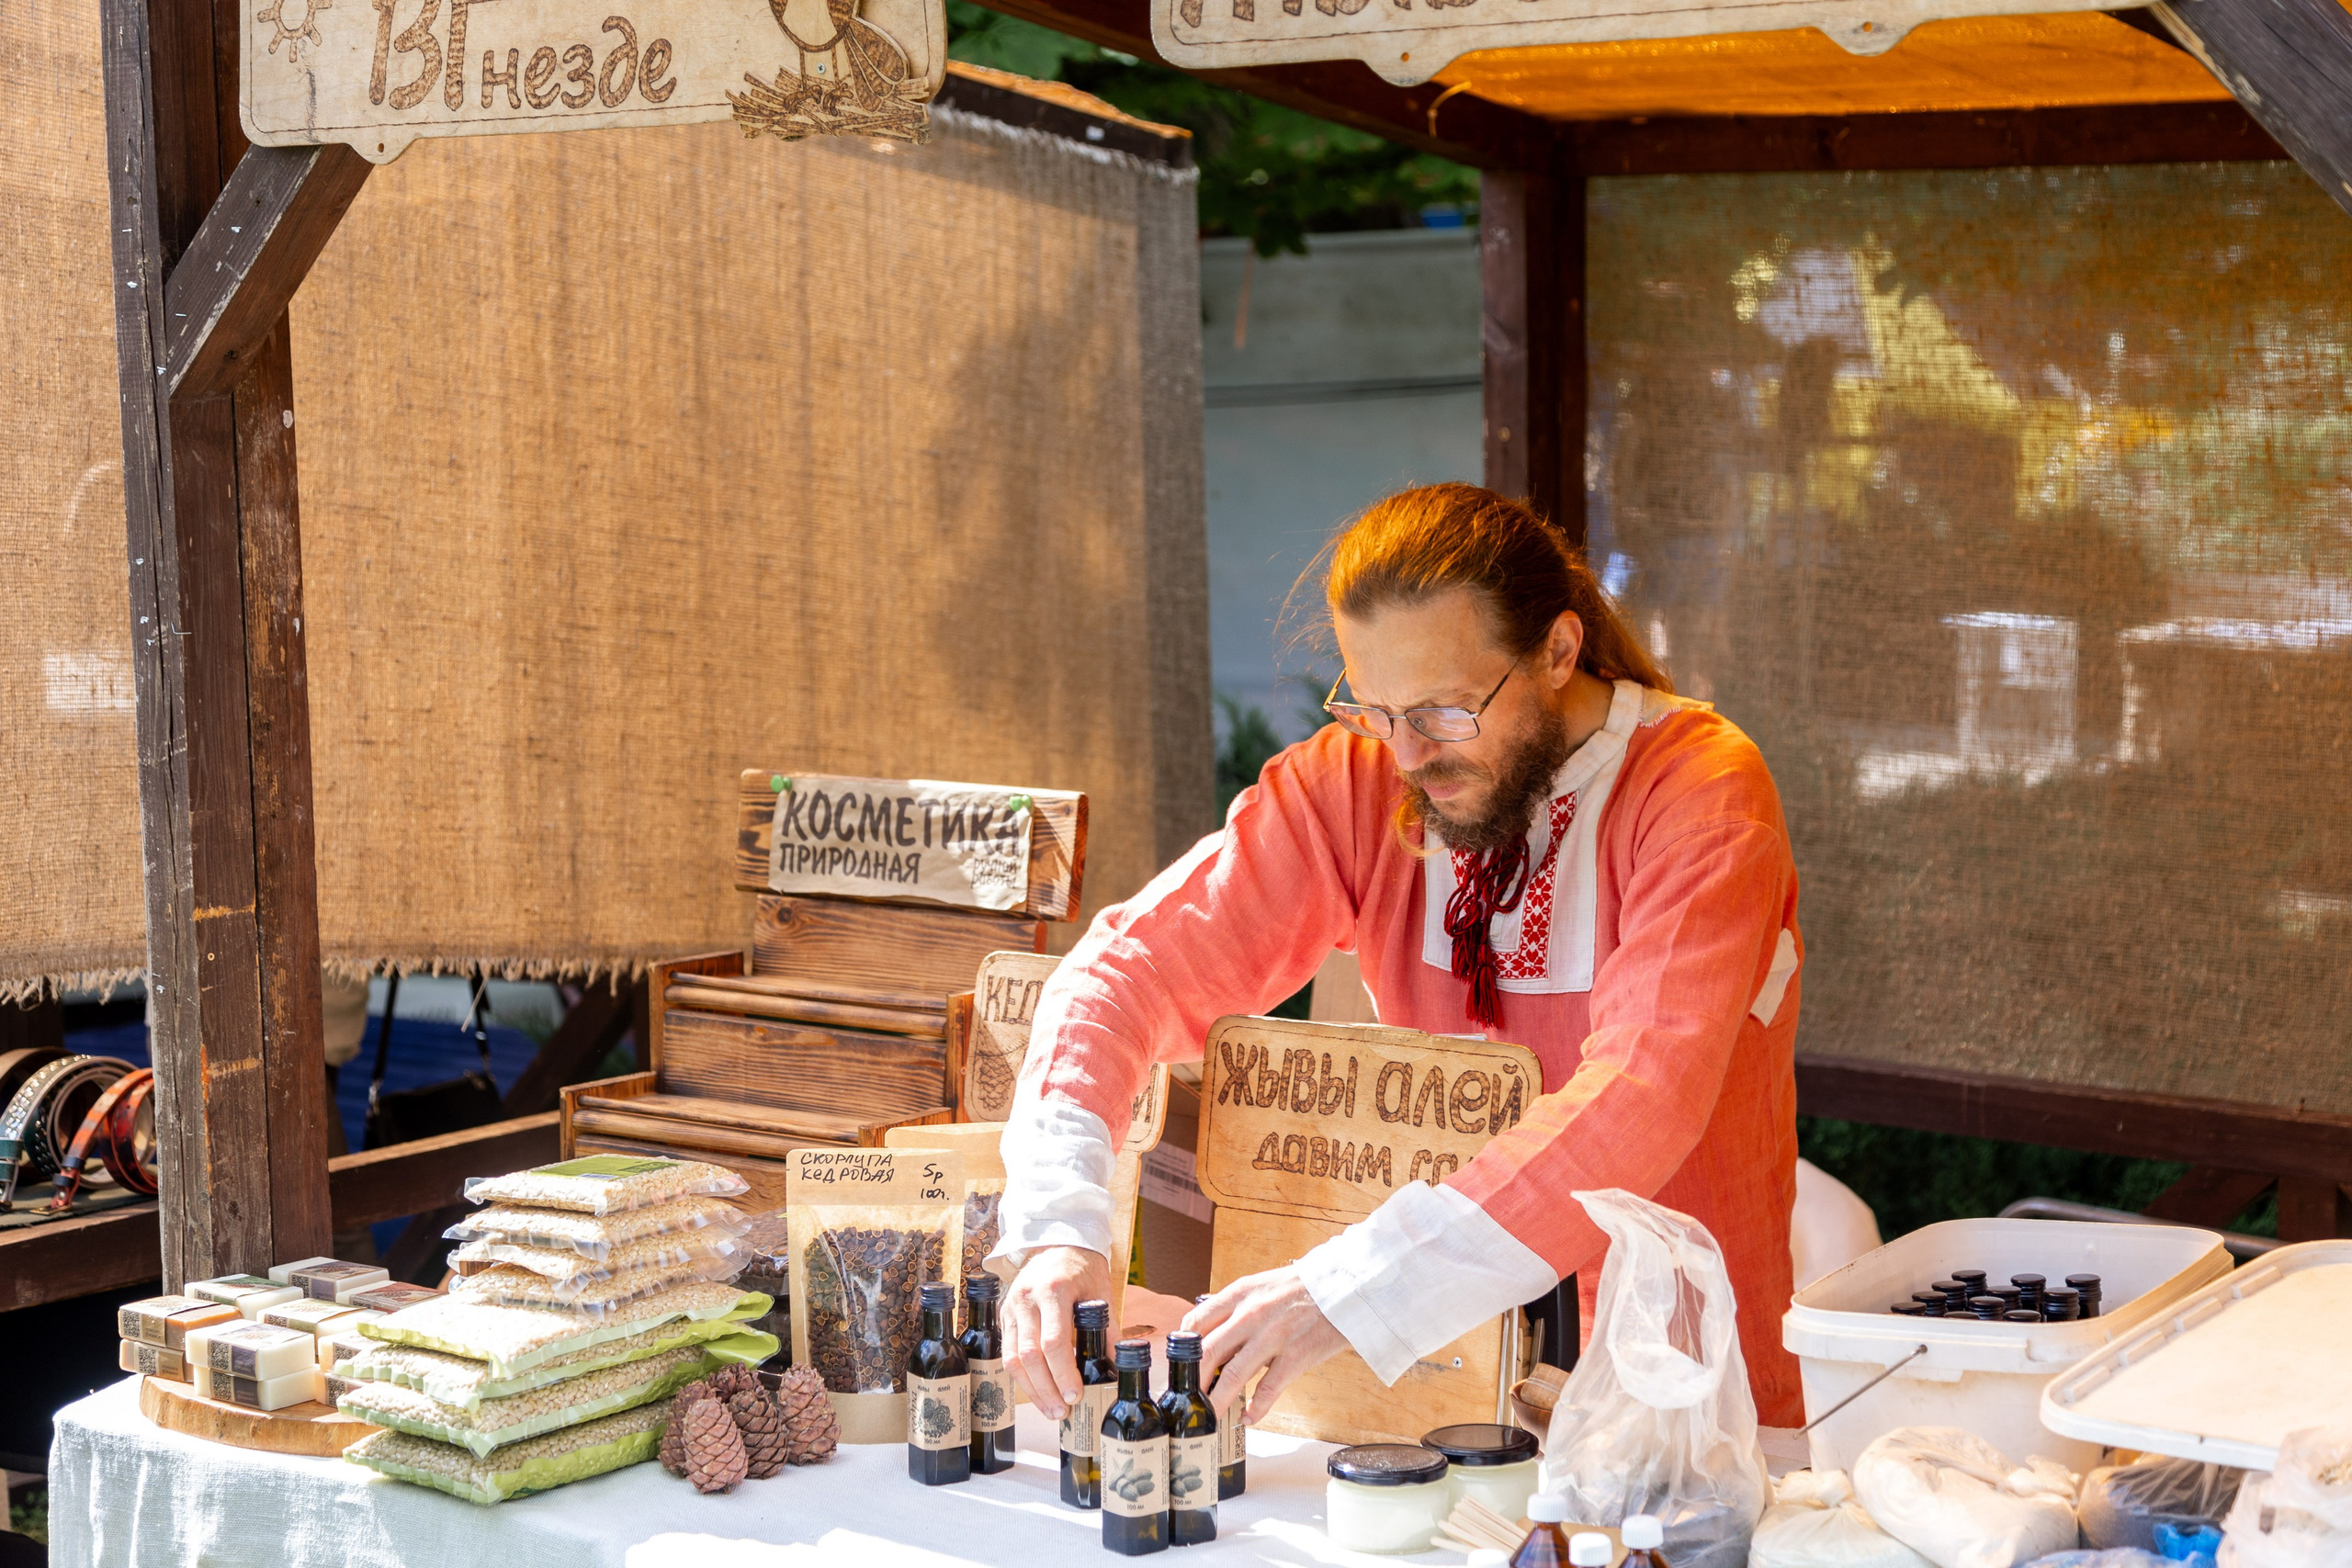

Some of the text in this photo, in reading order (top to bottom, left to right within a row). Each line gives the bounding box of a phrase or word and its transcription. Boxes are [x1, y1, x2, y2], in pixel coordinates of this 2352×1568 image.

[781, 789, 1020, 857] КОСМЕТИКА
[779, 842, 922, 885] ПРИРОДНАЯ
[800, 1153, 892, 1168] СКОРЛУПА
[1251, 1132, 1392, 1187] давим
